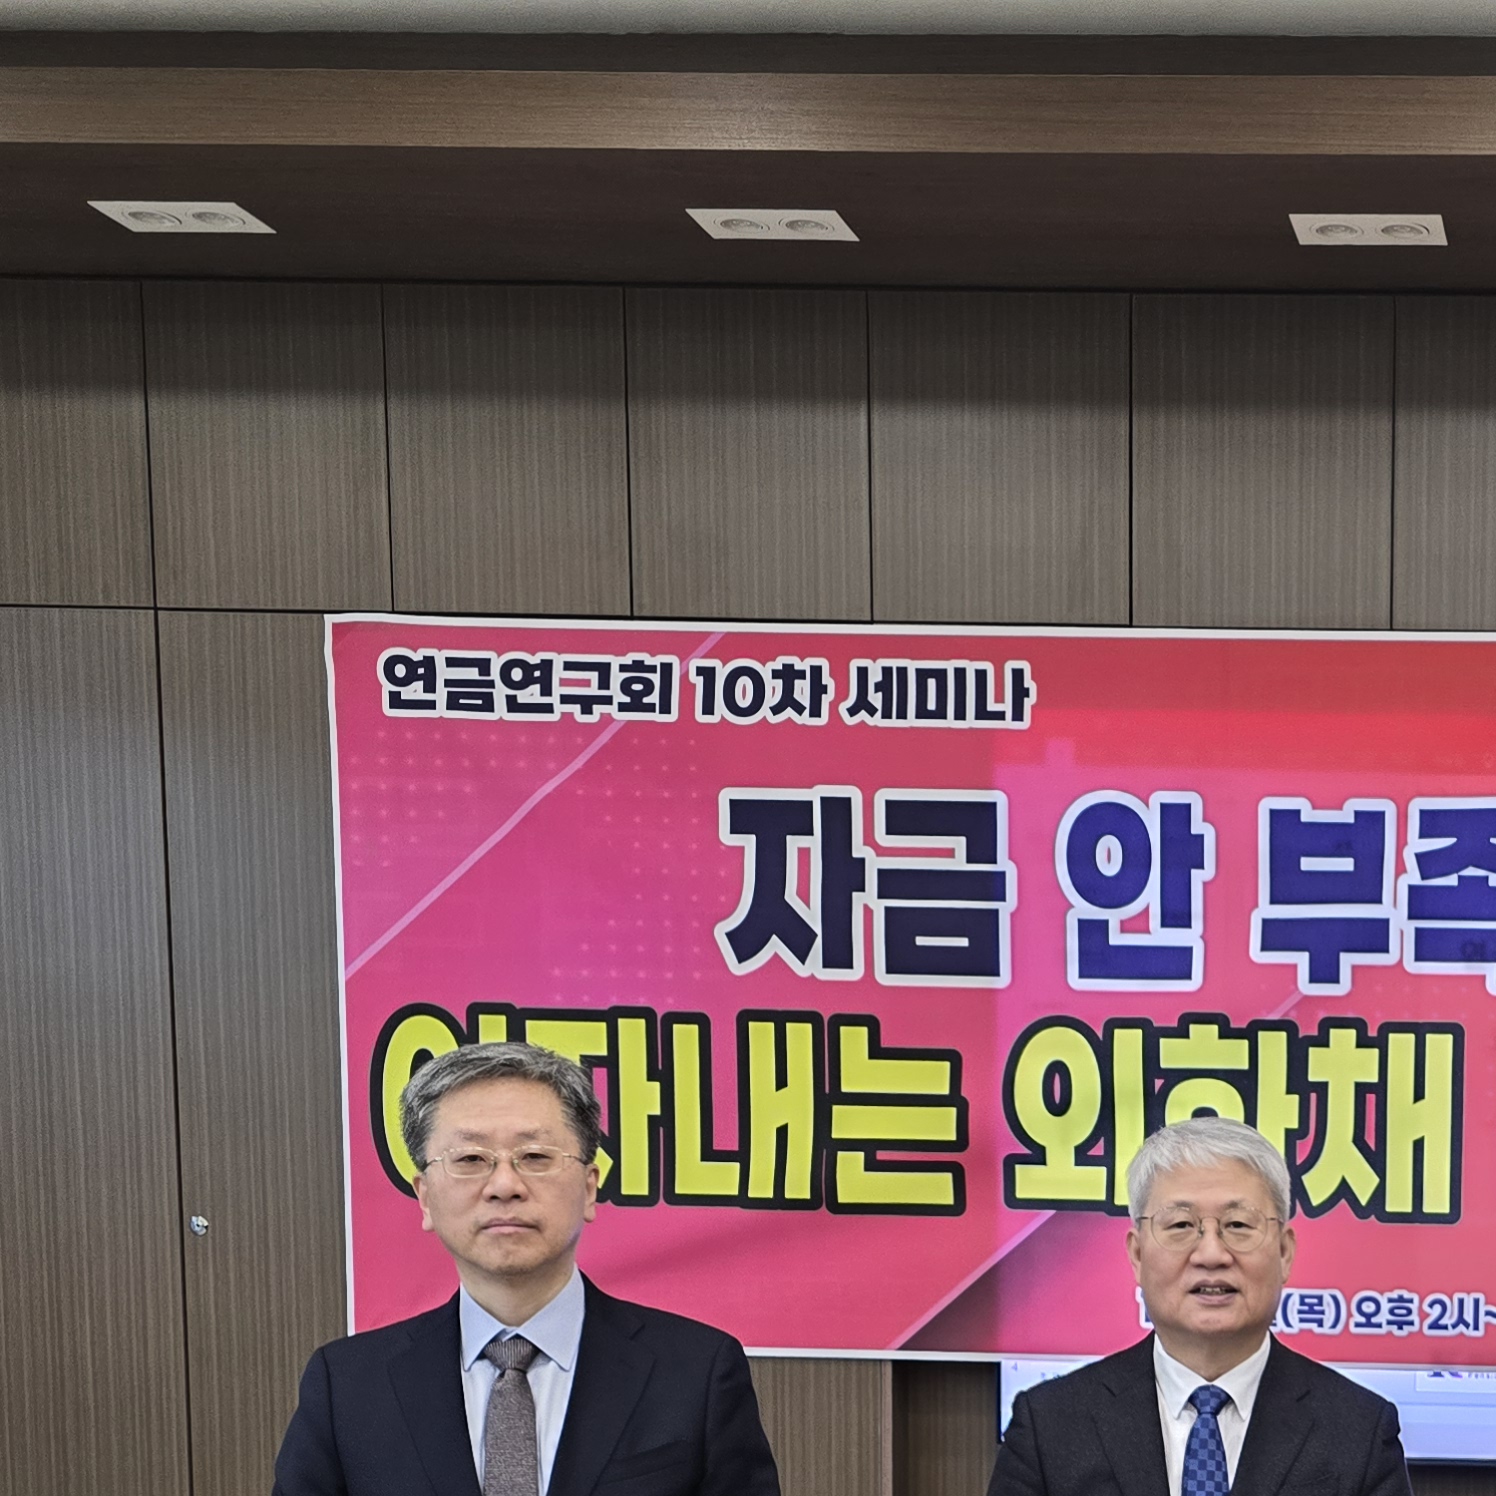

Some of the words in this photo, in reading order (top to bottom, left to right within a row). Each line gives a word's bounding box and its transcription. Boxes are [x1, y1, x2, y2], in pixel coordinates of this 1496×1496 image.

[379, 650, 678, 720] 연금연구회
[690, 661, 831, 723] 10차
[843, 661, 1034, 728] 세미나
[718, 790, 1013, 983] 자금
[1058, 794, 1213, 989] 안
[1352, 1292, 1417, 1333] 오후
